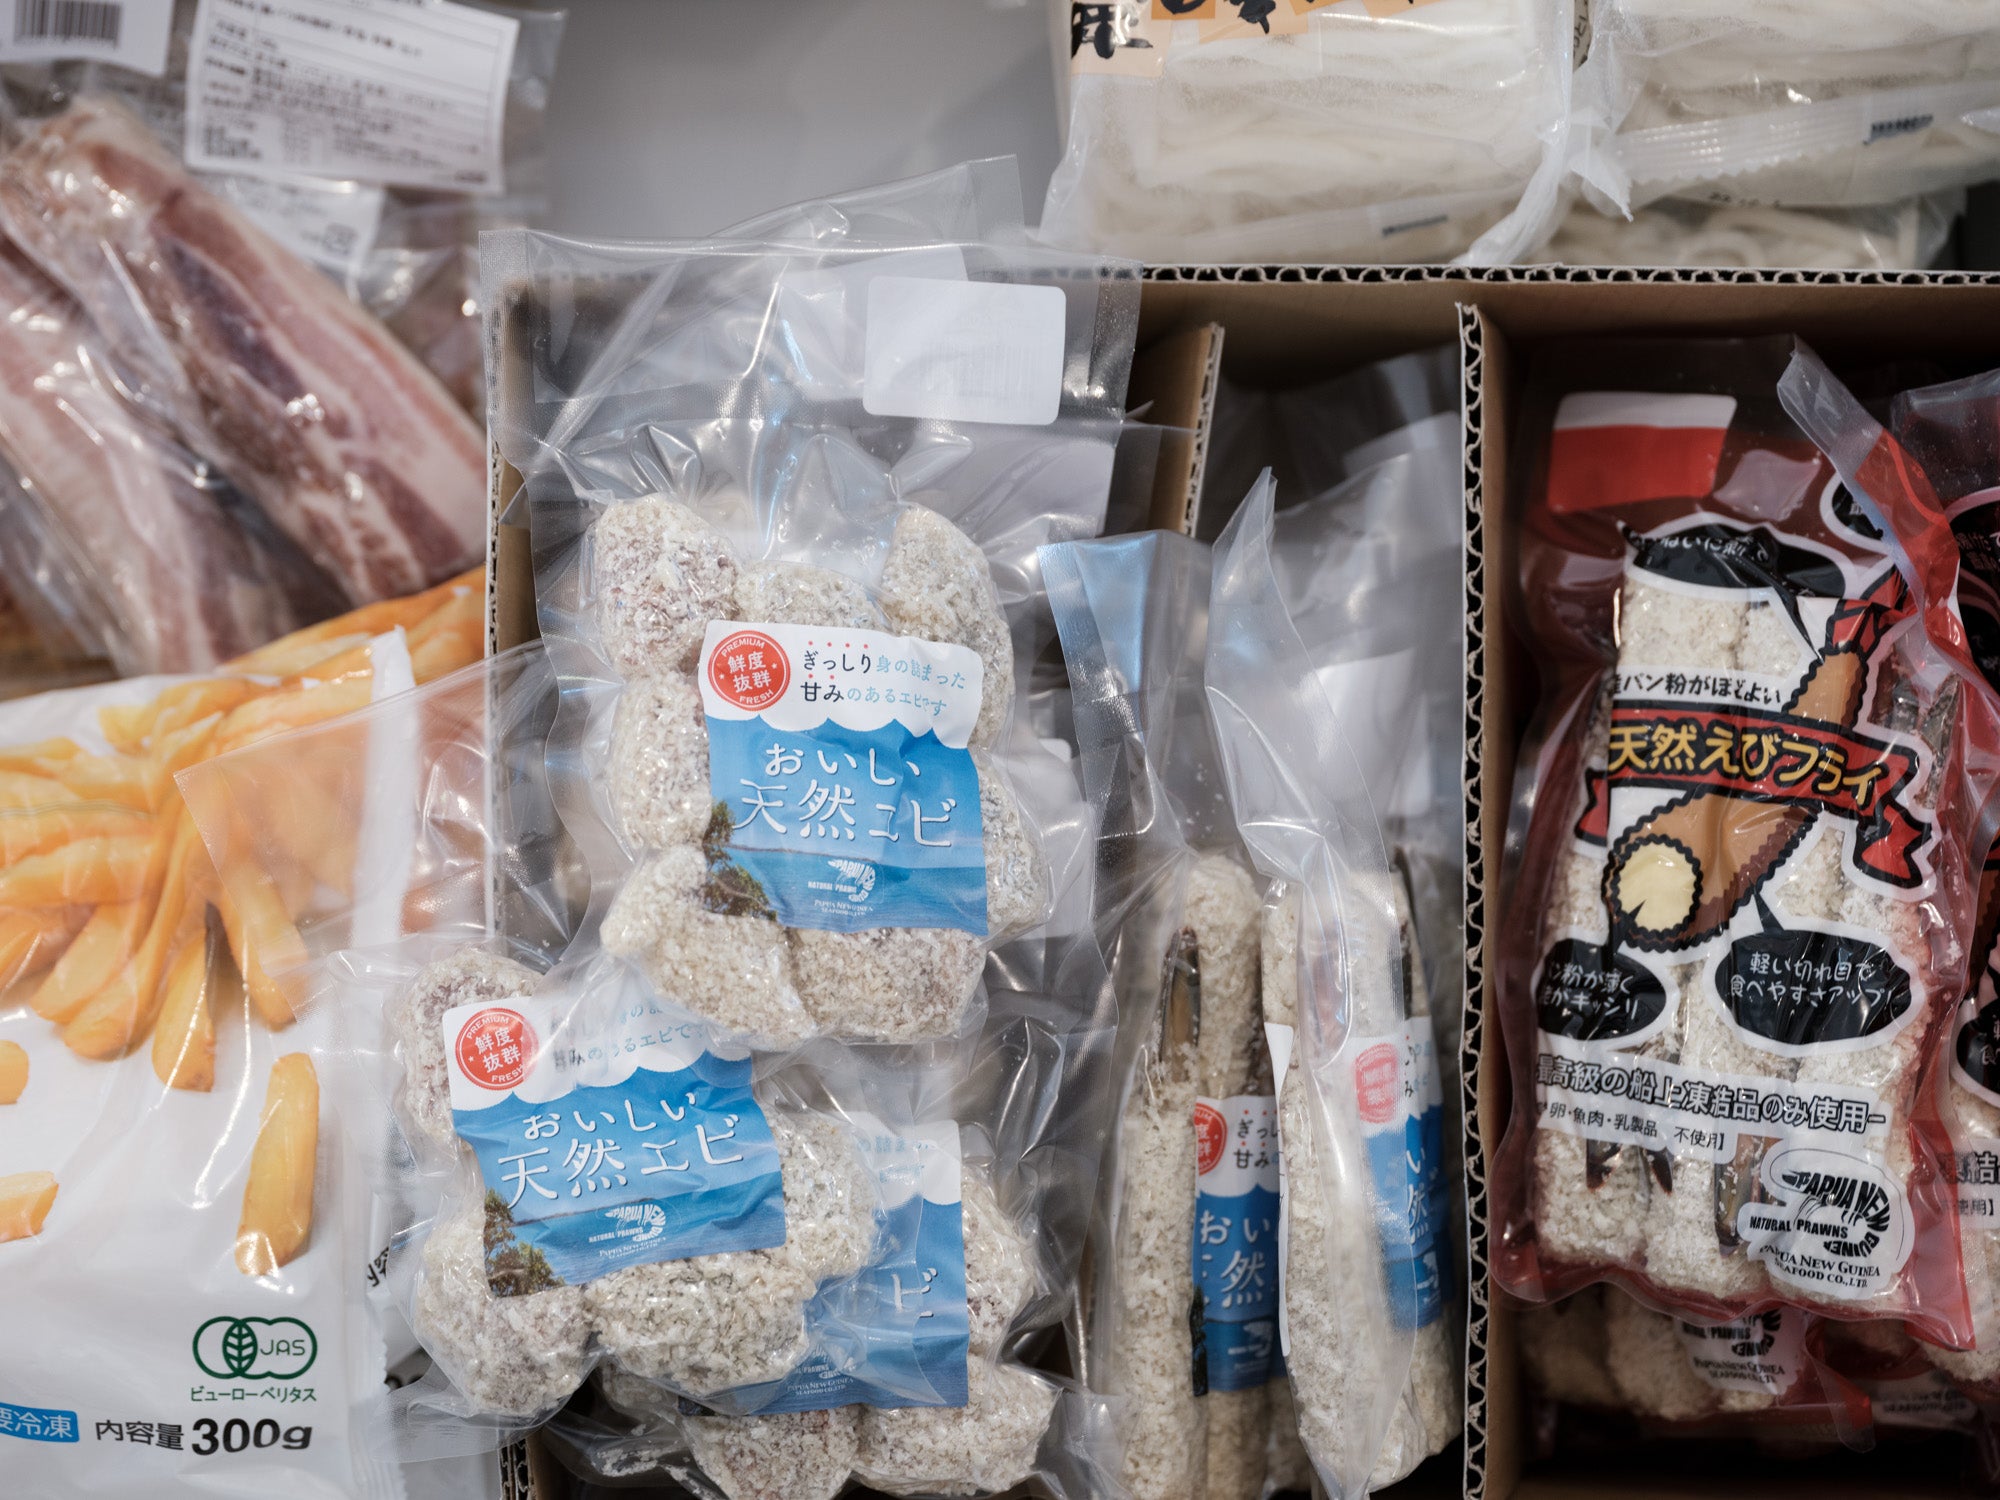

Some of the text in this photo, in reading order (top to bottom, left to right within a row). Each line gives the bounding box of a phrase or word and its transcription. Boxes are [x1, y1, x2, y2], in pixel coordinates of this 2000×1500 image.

[721, 638, 765, 657] PREMIUM
[728, 651, 766, 674] 鮮度
[803, 650, 967, 690] ぎっしり身の詰まった
[733, 669, 772, 693] 抜群
[739, 689, 774, 704] FRESH
[1608, 724, 1881, 806] 天然えびフライ
[732, 779, 957, 848] 天然エビ
[466, 1016, 510, 1040] PREMIUM
[475, 1027, 514, 1055] 鮮度
[482, 1044, 521, 1073] 抜群
[523, 1092, 696, 1140] おいしい
[497, 1114, 744, 1208] 天然エビ
[1795, 1171, 1859, 1210] PAPUA
[1853, 1180, 1890, 1232] NEW
[1749, 1216, 1849, 1239] NATURAL PRAWNS
[1760, 1244, 1881, 1278] PAPUA NEW GUINEA
[1774, 1257, 1824, 1281] SEAFOOD
[260, 1338, 306, 1356] JAS
[190, 1385, 317, 1403] ビューローベリタス
[95, 1417, 313, 1456] 内容量 300g
